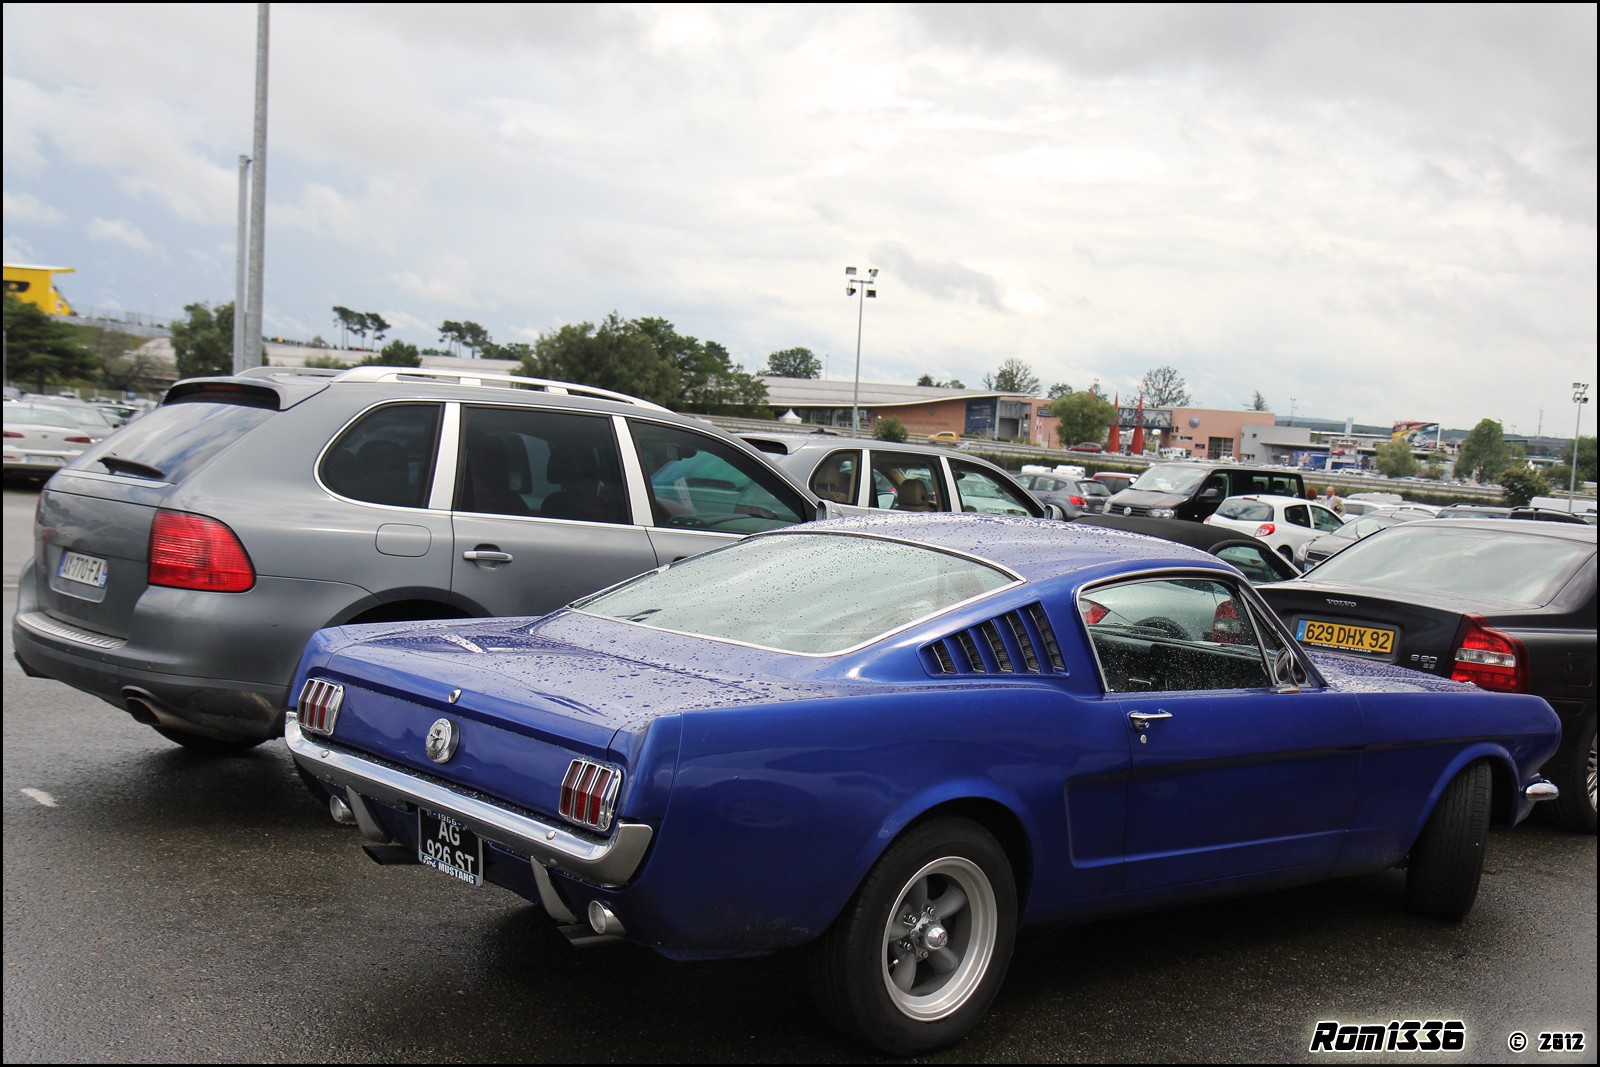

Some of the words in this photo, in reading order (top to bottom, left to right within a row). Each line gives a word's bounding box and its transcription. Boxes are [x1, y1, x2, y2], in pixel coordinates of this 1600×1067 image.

[1326, 598, 1357, 608] VOLVO
[1305, 623, 1335, 642] 629
[1336, 627, 1367, 646] DHX
[1369, 631, 1391, 650] 92
[438, 820, 461, 846] AG
[426, 839, 451, 865] 926
[455, 850, 475, 874] ST
[438, 860, 475, 885] MUSTANG
